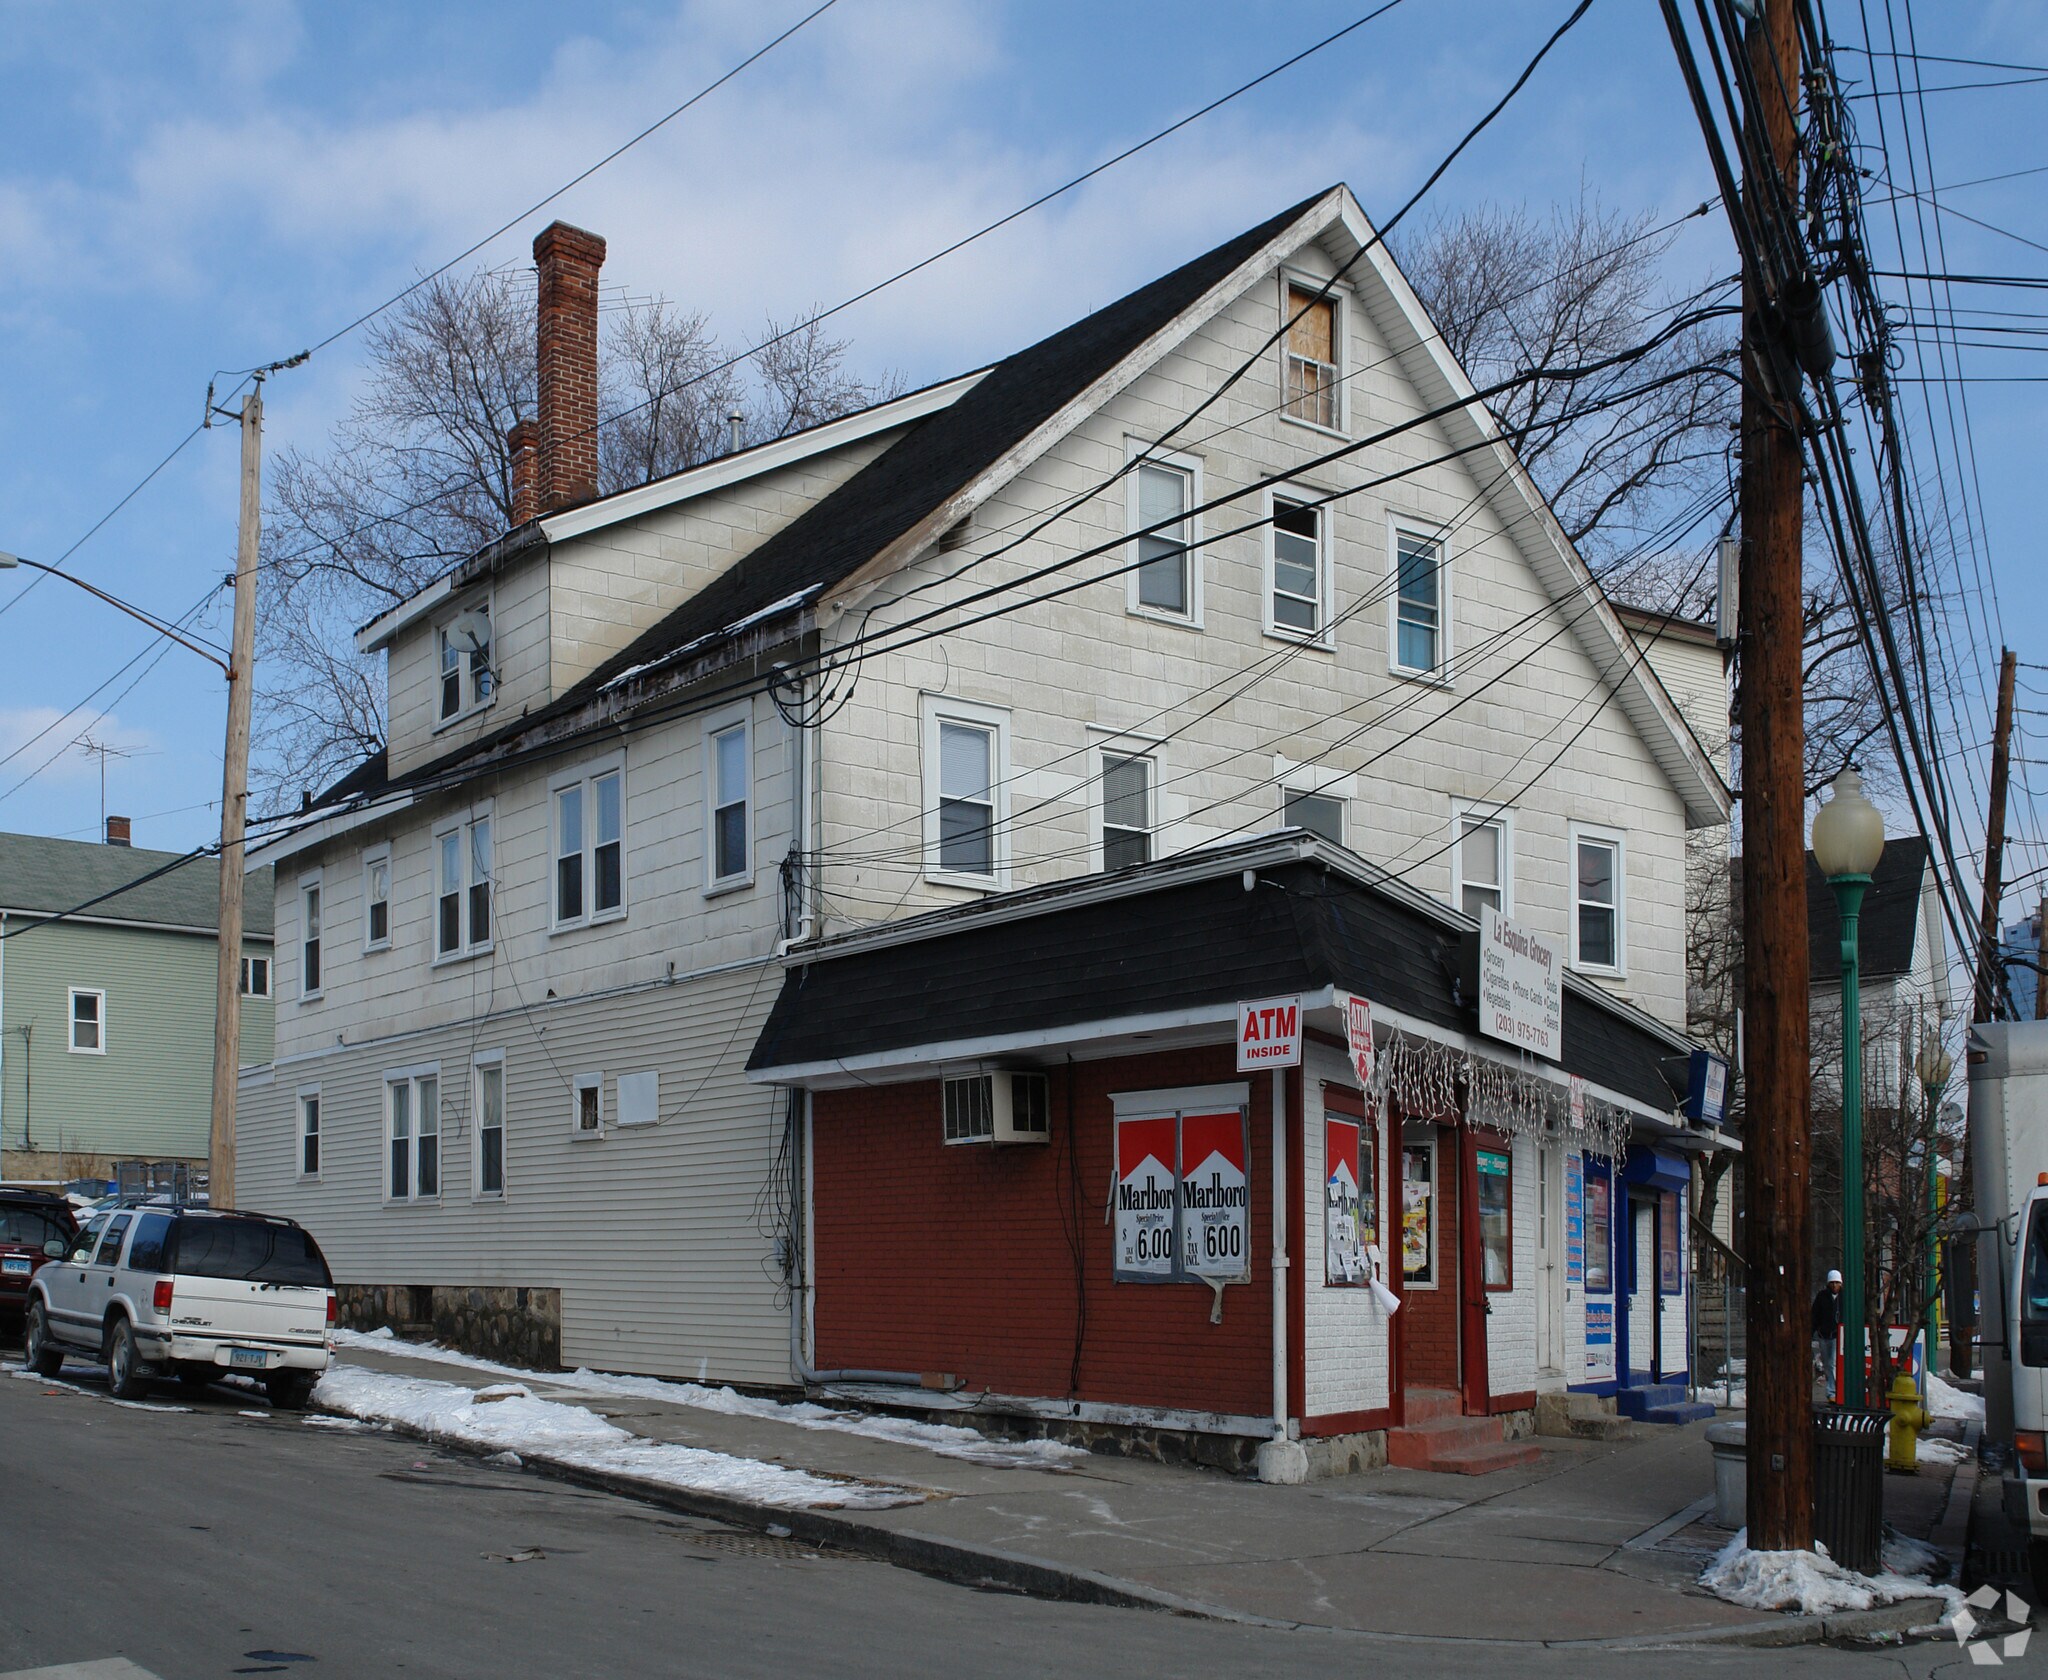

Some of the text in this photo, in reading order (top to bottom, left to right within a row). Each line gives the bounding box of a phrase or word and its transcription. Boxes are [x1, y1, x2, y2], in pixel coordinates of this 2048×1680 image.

[1493, 915, 1553, 975] La Esquina Grocery
[1486, 948, 1505, 973] Grocery
[1485, 968, 1510, 991] Cigarettes
[1546, 976, 1558, 995] Soda
[1485, 987, 1511, 1011] Vegetables
[1514, 981, 1543, 1006] Phone Cards
[1546, 996, 1560, 1016] Candy
[1243, 1005, 1297, 1042] ATM
[1495, 1012, 1549, 1047] (203) 975-7763
[1246, 1044, 1291, 1059] INSIDE
[1181, 1173, 1246, 1209] Marlboro
[1122, 1227, 1172, 1260] $ 6.00
[1187, 1225, 1241, 1257] $ 600
[1187, 1242, 1199, 1254] TAX
